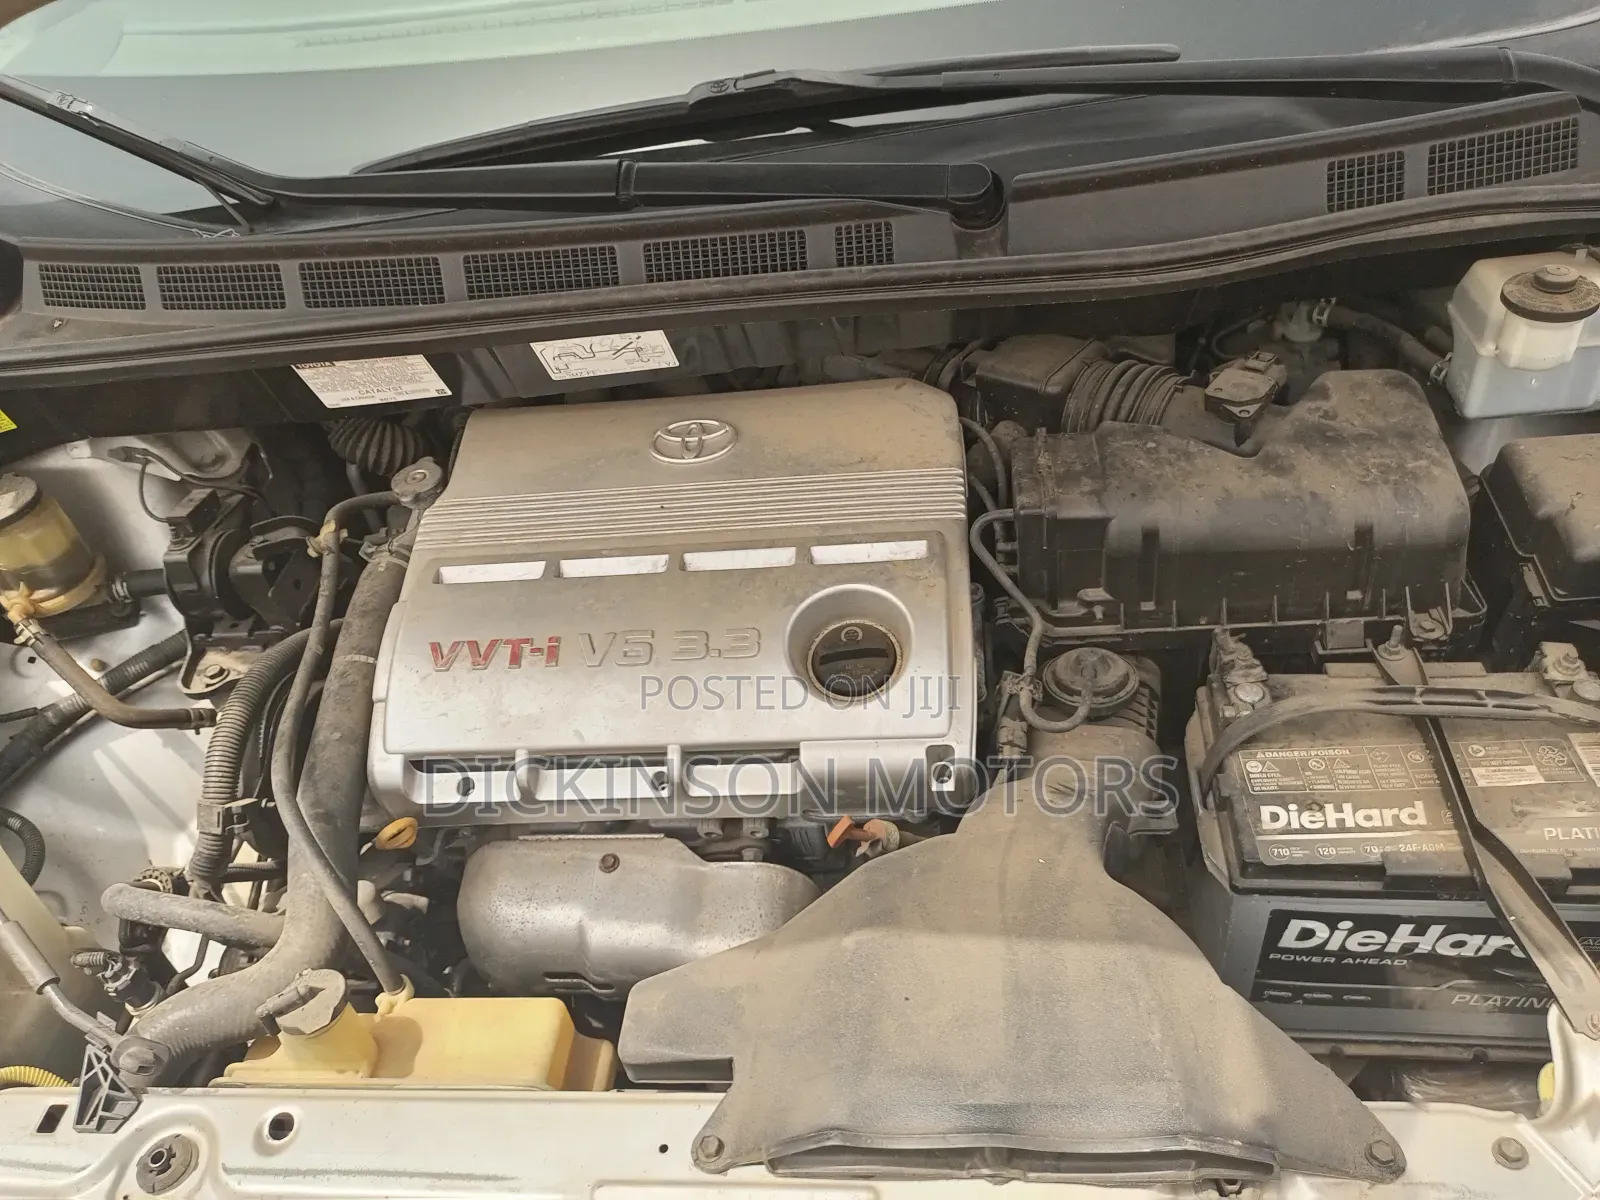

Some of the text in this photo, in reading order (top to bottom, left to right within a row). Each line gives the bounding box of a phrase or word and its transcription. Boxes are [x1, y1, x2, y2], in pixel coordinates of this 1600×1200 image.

[295, 361, 332, 369] TOYOTA
[357, 385, 403, 395] CATALYST
[429, 626, 762, 672] VVT-i V6 3.3
[1265, 748, 1350, 758] DANGER/POISON
[1260, 800, 1428, 829] DieHard
[1543, 826, 1600, 840] PLATI
[1272, 848, 1290, 856] 710
[1318, 847, 1336, 855] 120
[1268, 953, 1408, 966] POWER AHEAD
[1450, 994, 1555, 1009] PLATIN
